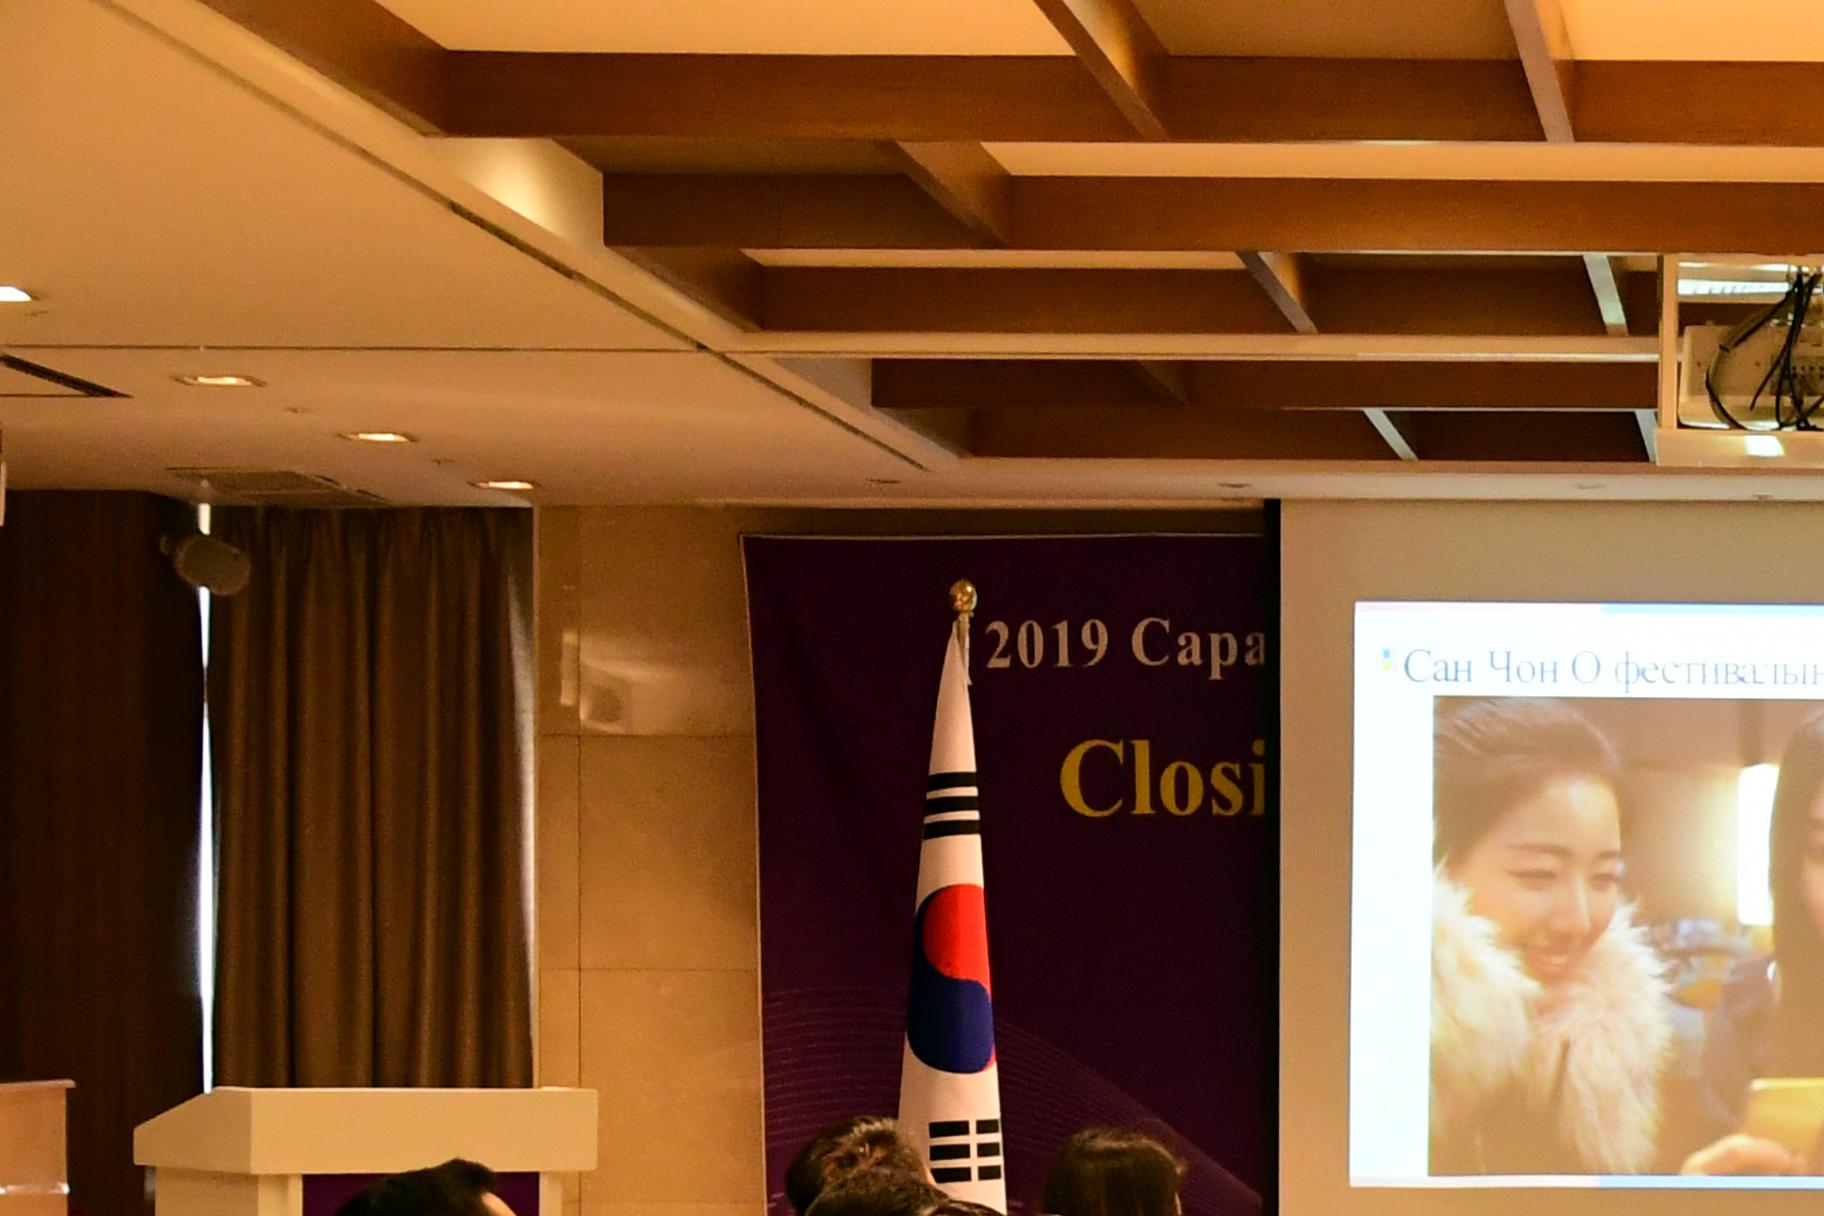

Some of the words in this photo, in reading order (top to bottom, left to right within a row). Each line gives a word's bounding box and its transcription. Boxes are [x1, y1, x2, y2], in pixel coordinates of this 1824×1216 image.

[985, 618, 1109, 670] 2019
[1131, 617, 1265, 680] Capa
[1404, 648, 1473, 684] Сан
[1488, 650, 1559, 685] Чон
[1571, 650, 1602, 685] О
[1059, 738, 1265, 818] Closi
